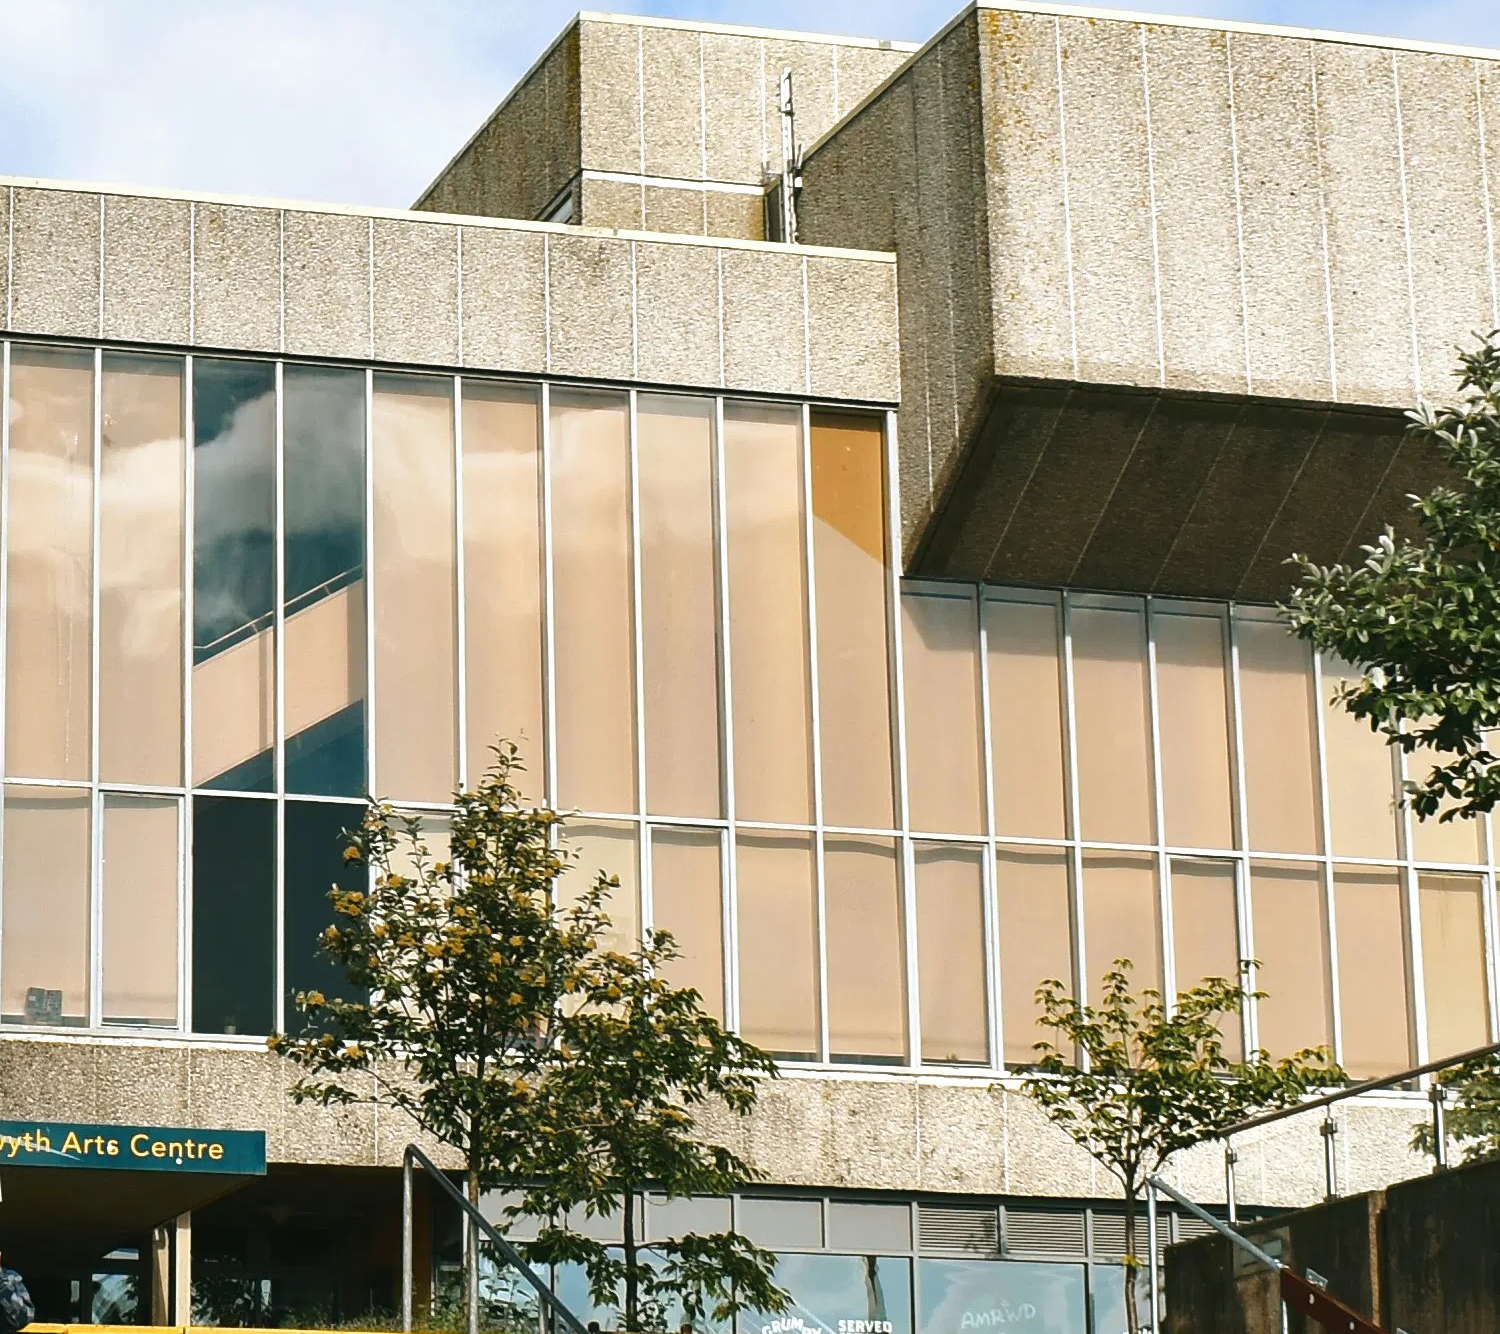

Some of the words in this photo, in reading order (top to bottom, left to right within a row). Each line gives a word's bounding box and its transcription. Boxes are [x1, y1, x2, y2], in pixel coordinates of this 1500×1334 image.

[62, 1131, 119, 1156] Arts
[130, 1133, 224, 1160] Centre
[839, 1319, 892, 1334] SERVED
